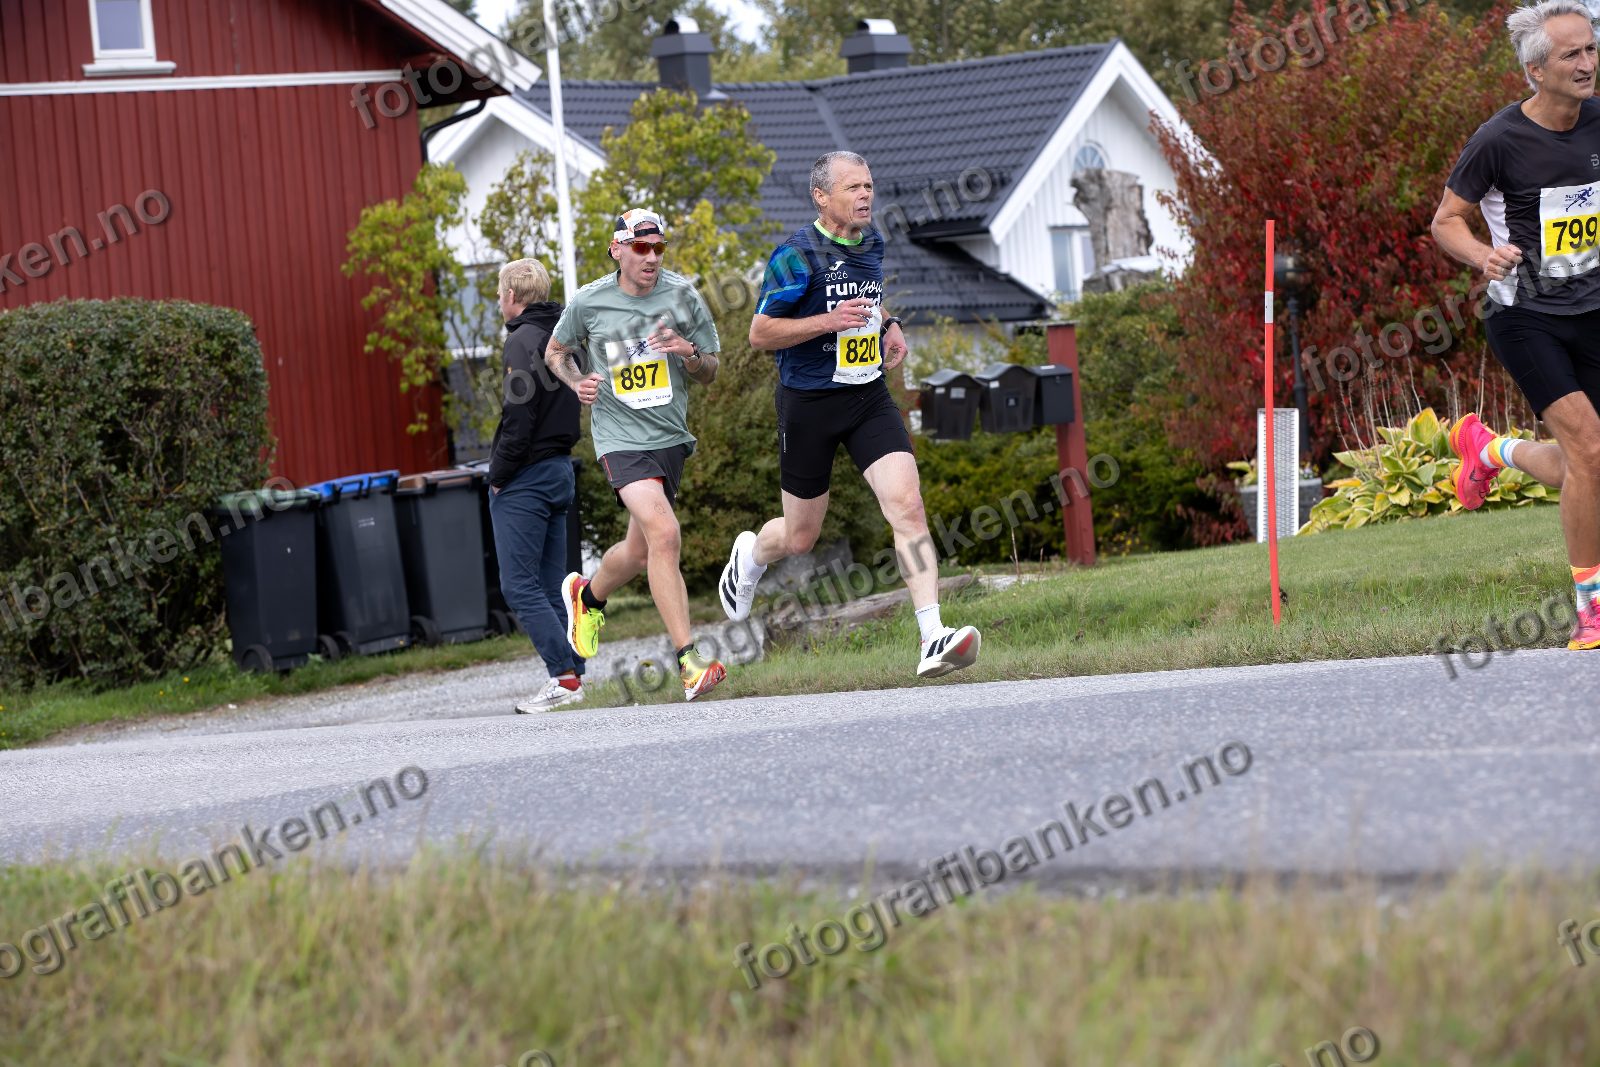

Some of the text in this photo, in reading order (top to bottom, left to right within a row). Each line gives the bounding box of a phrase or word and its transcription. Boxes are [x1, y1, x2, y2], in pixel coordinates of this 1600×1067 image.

[1553, 217, 1597, 251] 799
[825, 271, 848, 281] 2026
[826, 282, 858, 297] run
[846, 336, 876, 364] 820
[621, 363, 659, 391] 897
